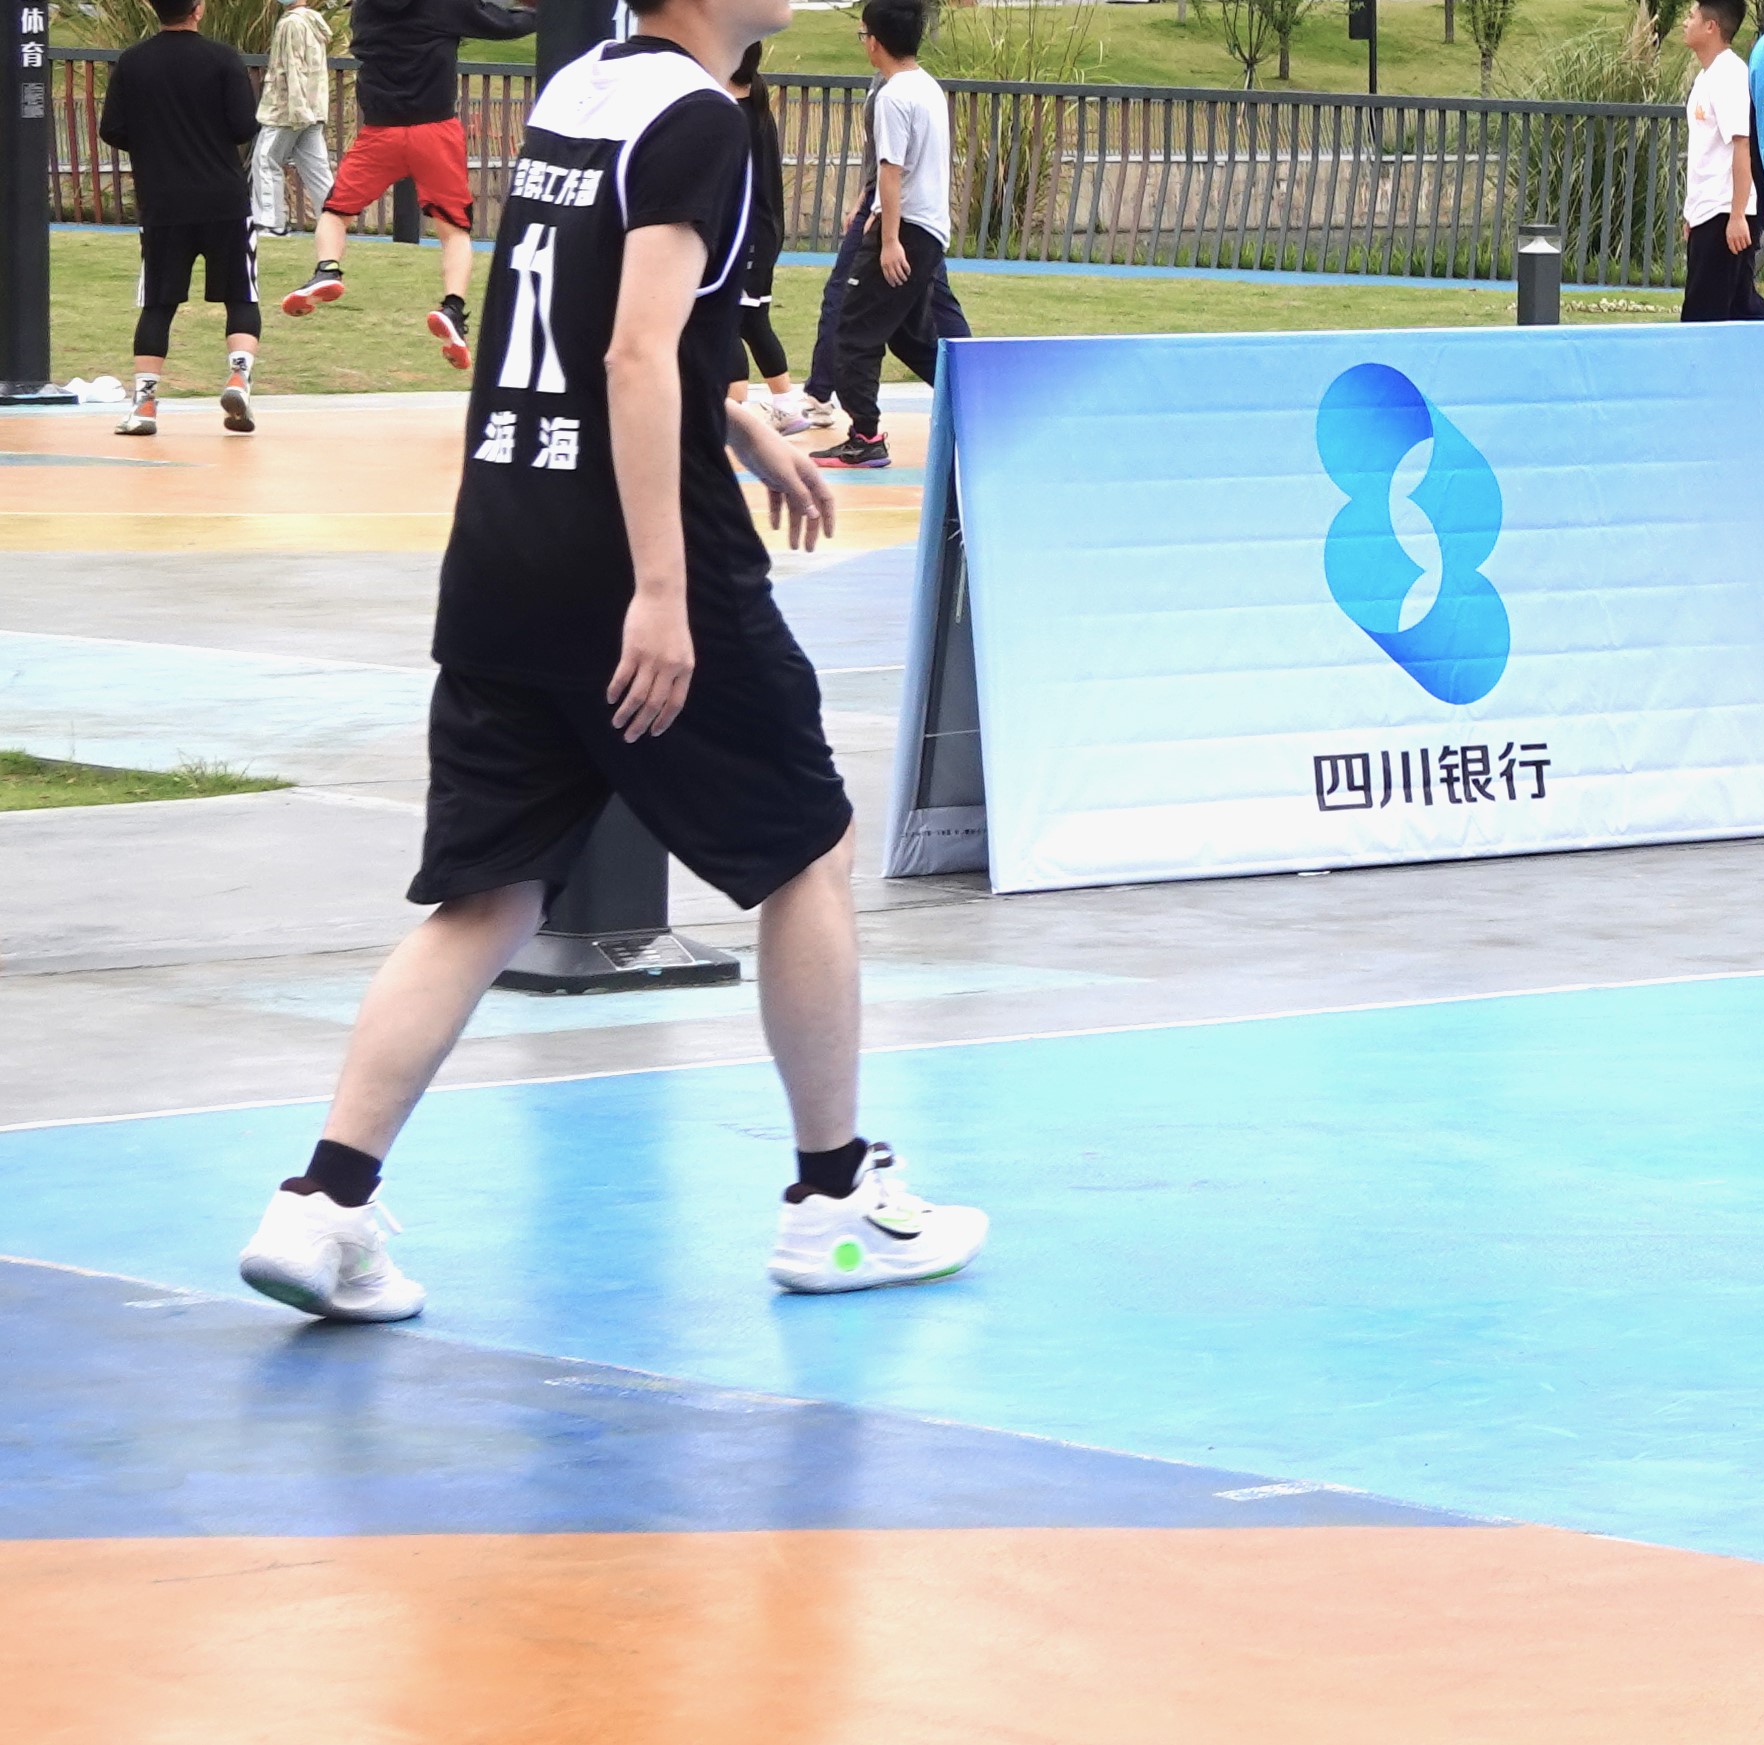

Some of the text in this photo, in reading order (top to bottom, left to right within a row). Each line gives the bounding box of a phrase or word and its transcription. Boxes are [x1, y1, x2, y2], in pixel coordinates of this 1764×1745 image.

[498, 223, 567, 394] 11
[1312, 741, 1552, 812] 四川银行
